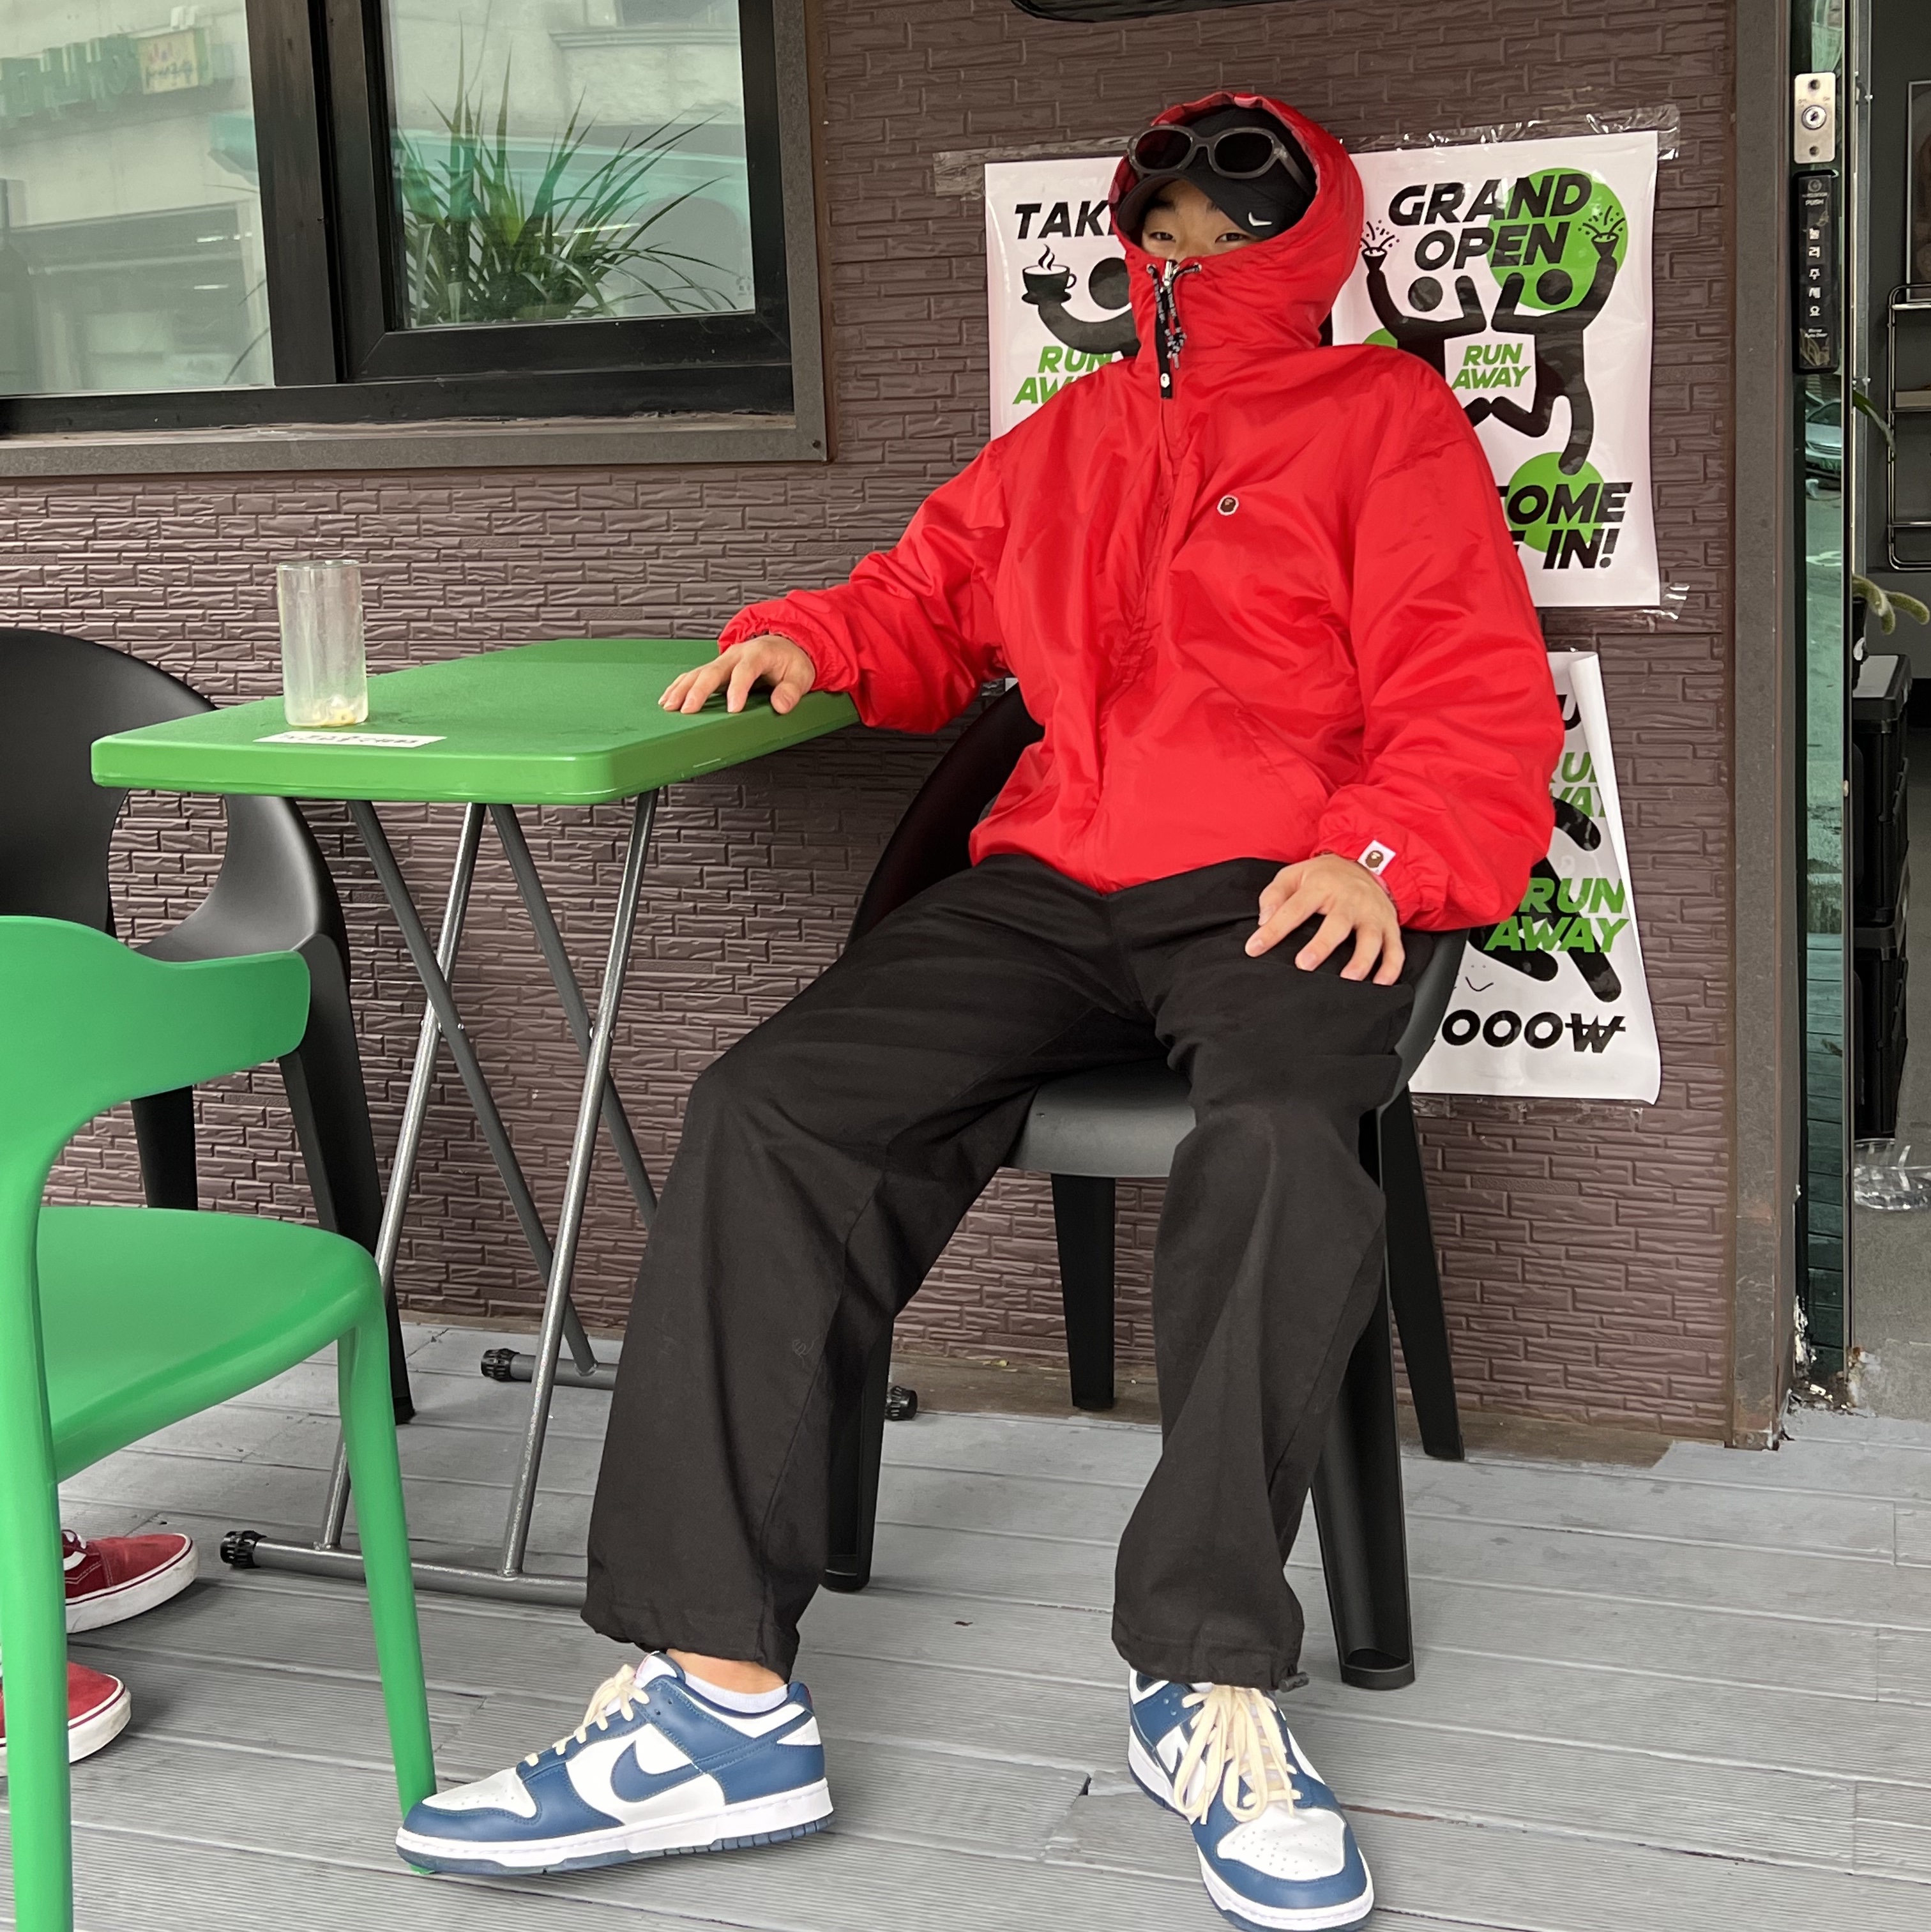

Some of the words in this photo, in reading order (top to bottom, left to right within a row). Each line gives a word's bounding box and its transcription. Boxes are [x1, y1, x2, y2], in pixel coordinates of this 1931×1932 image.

[1388, 173, 1593, 226] GRAND
[1015, 200, 1116, 240] TAK
[1414, 222, 1571, 271] OPEN
[1462, 343, 1523, 366] RUN
[1451, 365, 1532, 390] AWAY
[1497, 482, 1633, 525] OME
[1543, 528, 1620, 570] IN!
[1518, 878, 1626, 914] RUN
[1483, 915, 1630, 954] AWAY
